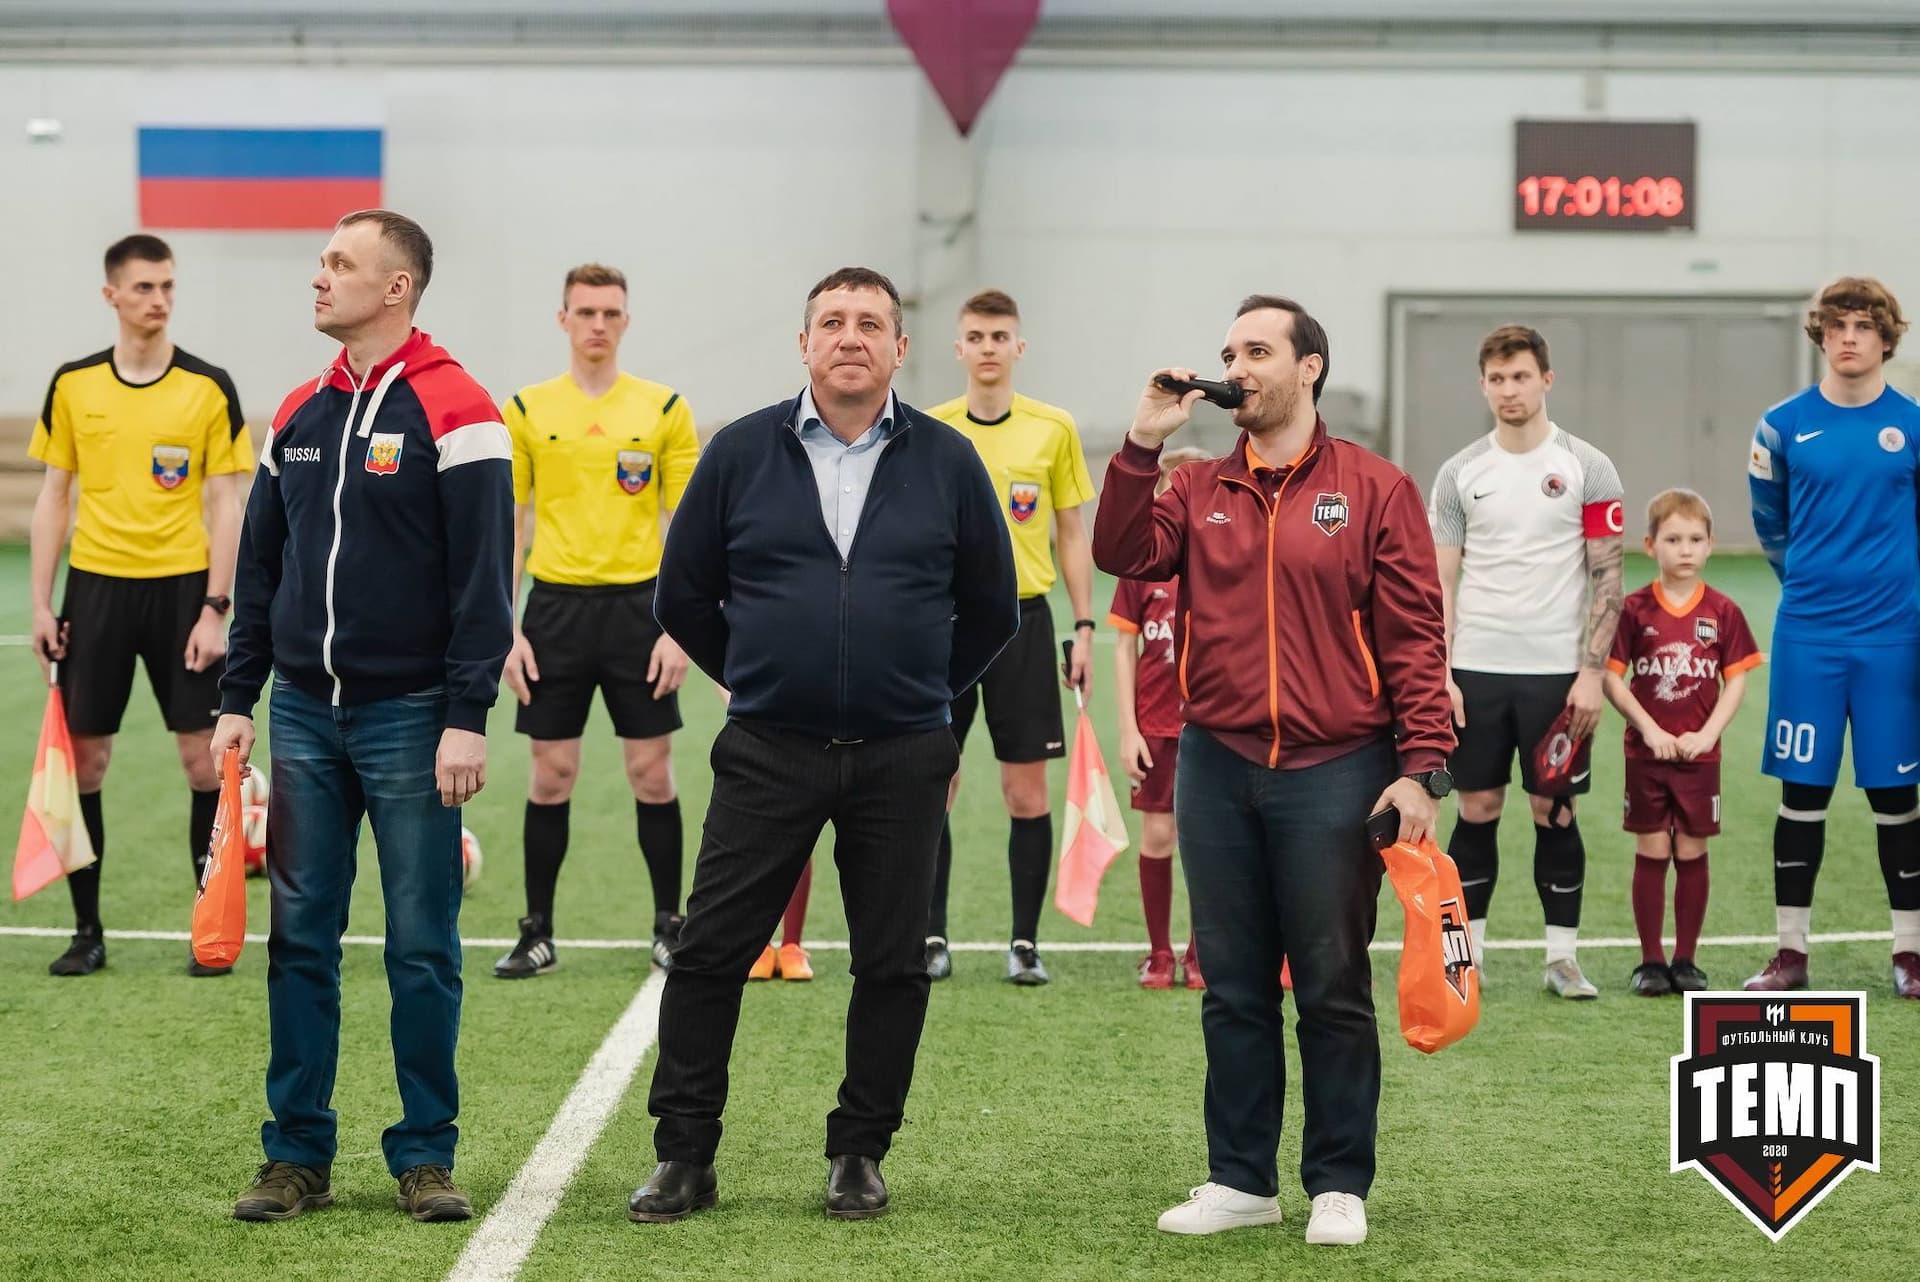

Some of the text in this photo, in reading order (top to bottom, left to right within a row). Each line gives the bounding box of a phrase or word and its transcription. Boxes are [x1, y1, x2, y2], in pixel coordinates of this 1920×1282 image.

[284, 447, 321, 462] RUSSIA
[1606, 501, 1624, 533] C
[1143, 620, 1175, 641] GA
[1636, 656, 1718, 679] GALAXY
[1774, 718, 1816, 764] 90
